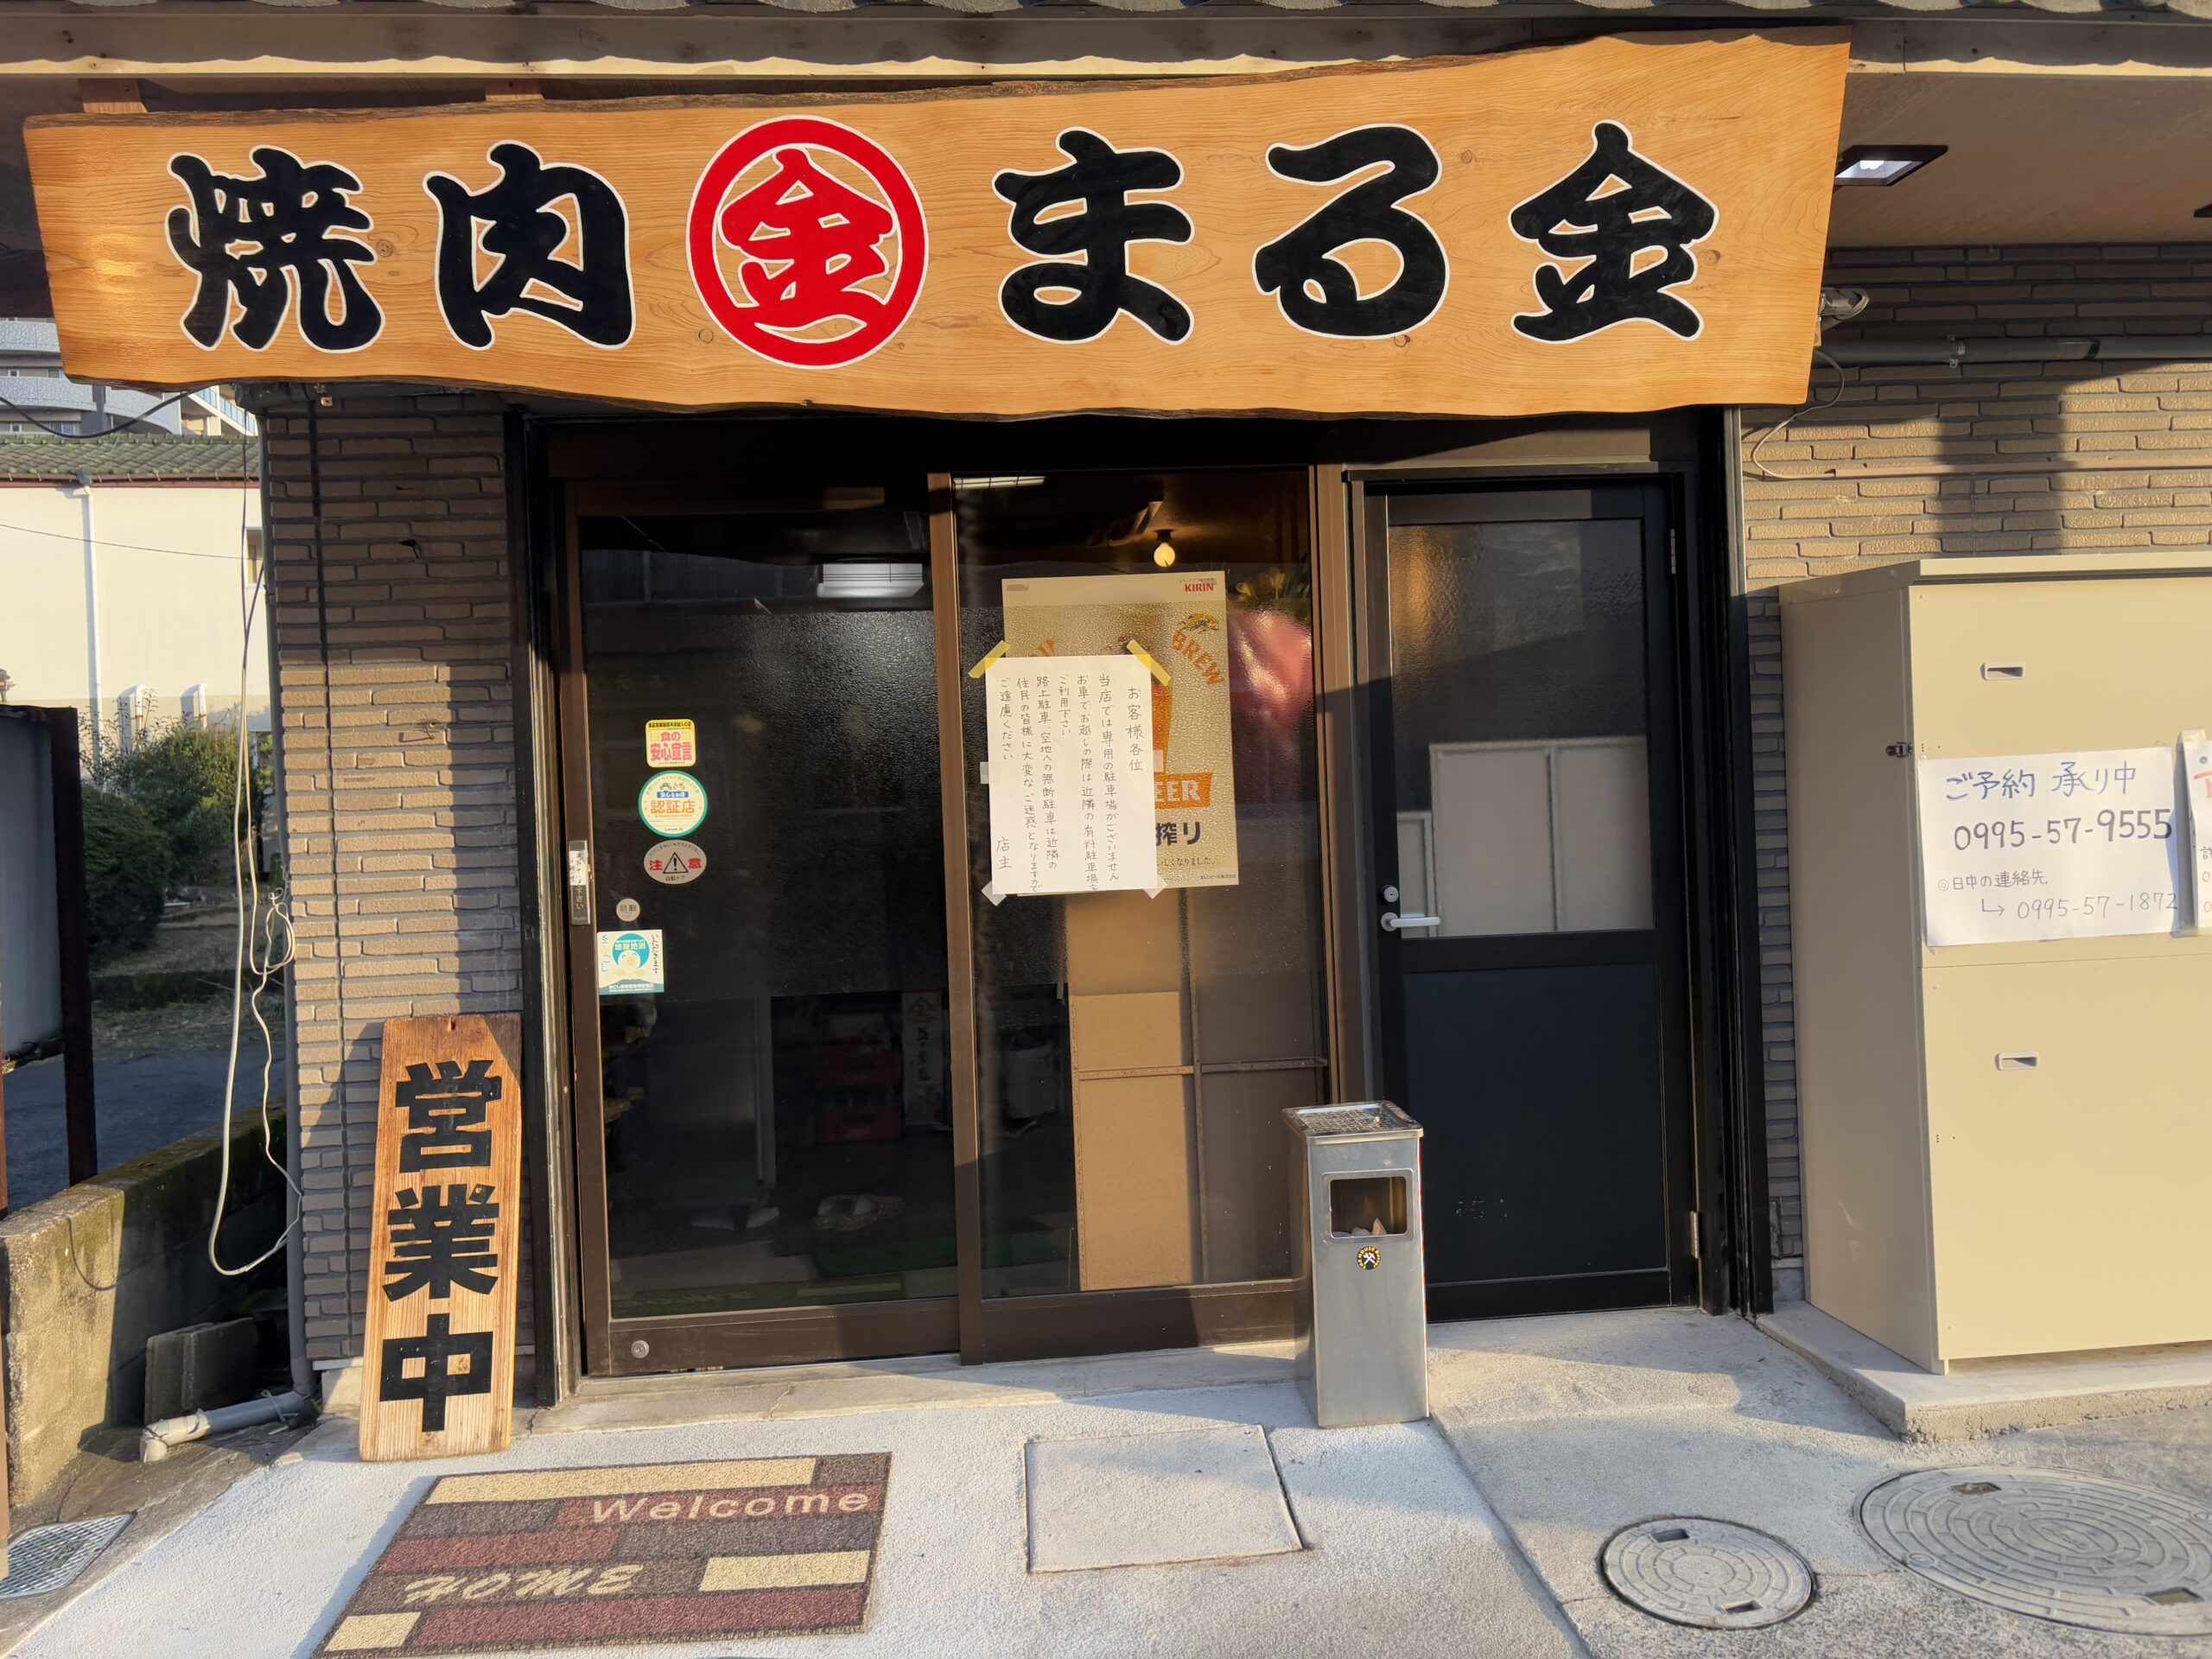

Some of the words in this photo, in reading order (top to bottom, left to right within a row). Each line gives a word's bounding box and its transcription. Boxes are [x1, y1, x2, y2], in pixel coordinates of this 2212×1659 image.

[165, 139, 636, 353] 焼肉
[715, 143, 899, 347] 金
[992, 119, 1719, 345] まる金
[1185, 583, 1214, 592] KIRIN
[1173, 631, 1225, 685] BREW
[1000, 677, 1013, 760] ご遠慮ください
[1058, 674, 1071, 736] ご利用下さい
[661, 732, 681, 741] 食の
[1125, 687, 1144, 772] お客様各位
[651, 742, 692, 761] 安心宣言
[1099, 673, 1119, 881] 当店では専用の駐車場がございません
[1946, 769, 2036, 800] ご予約
[2050, 760, 2137, 797] 承り中
[651, 800, 696, 813] 認証店
[1155, 822, 1201, 846] 搾り
[1954, 809, 2172, 850] 0995-57-9555
[996, 836, 1013, 869] 店主
[2018, 893, 2178, 920] 0995-57-1872
[379, 1059, 502, 1432] 営業中
[594, 1493, 869, 1523] Welcome
[404, 1565, 644, 1605] HOME
